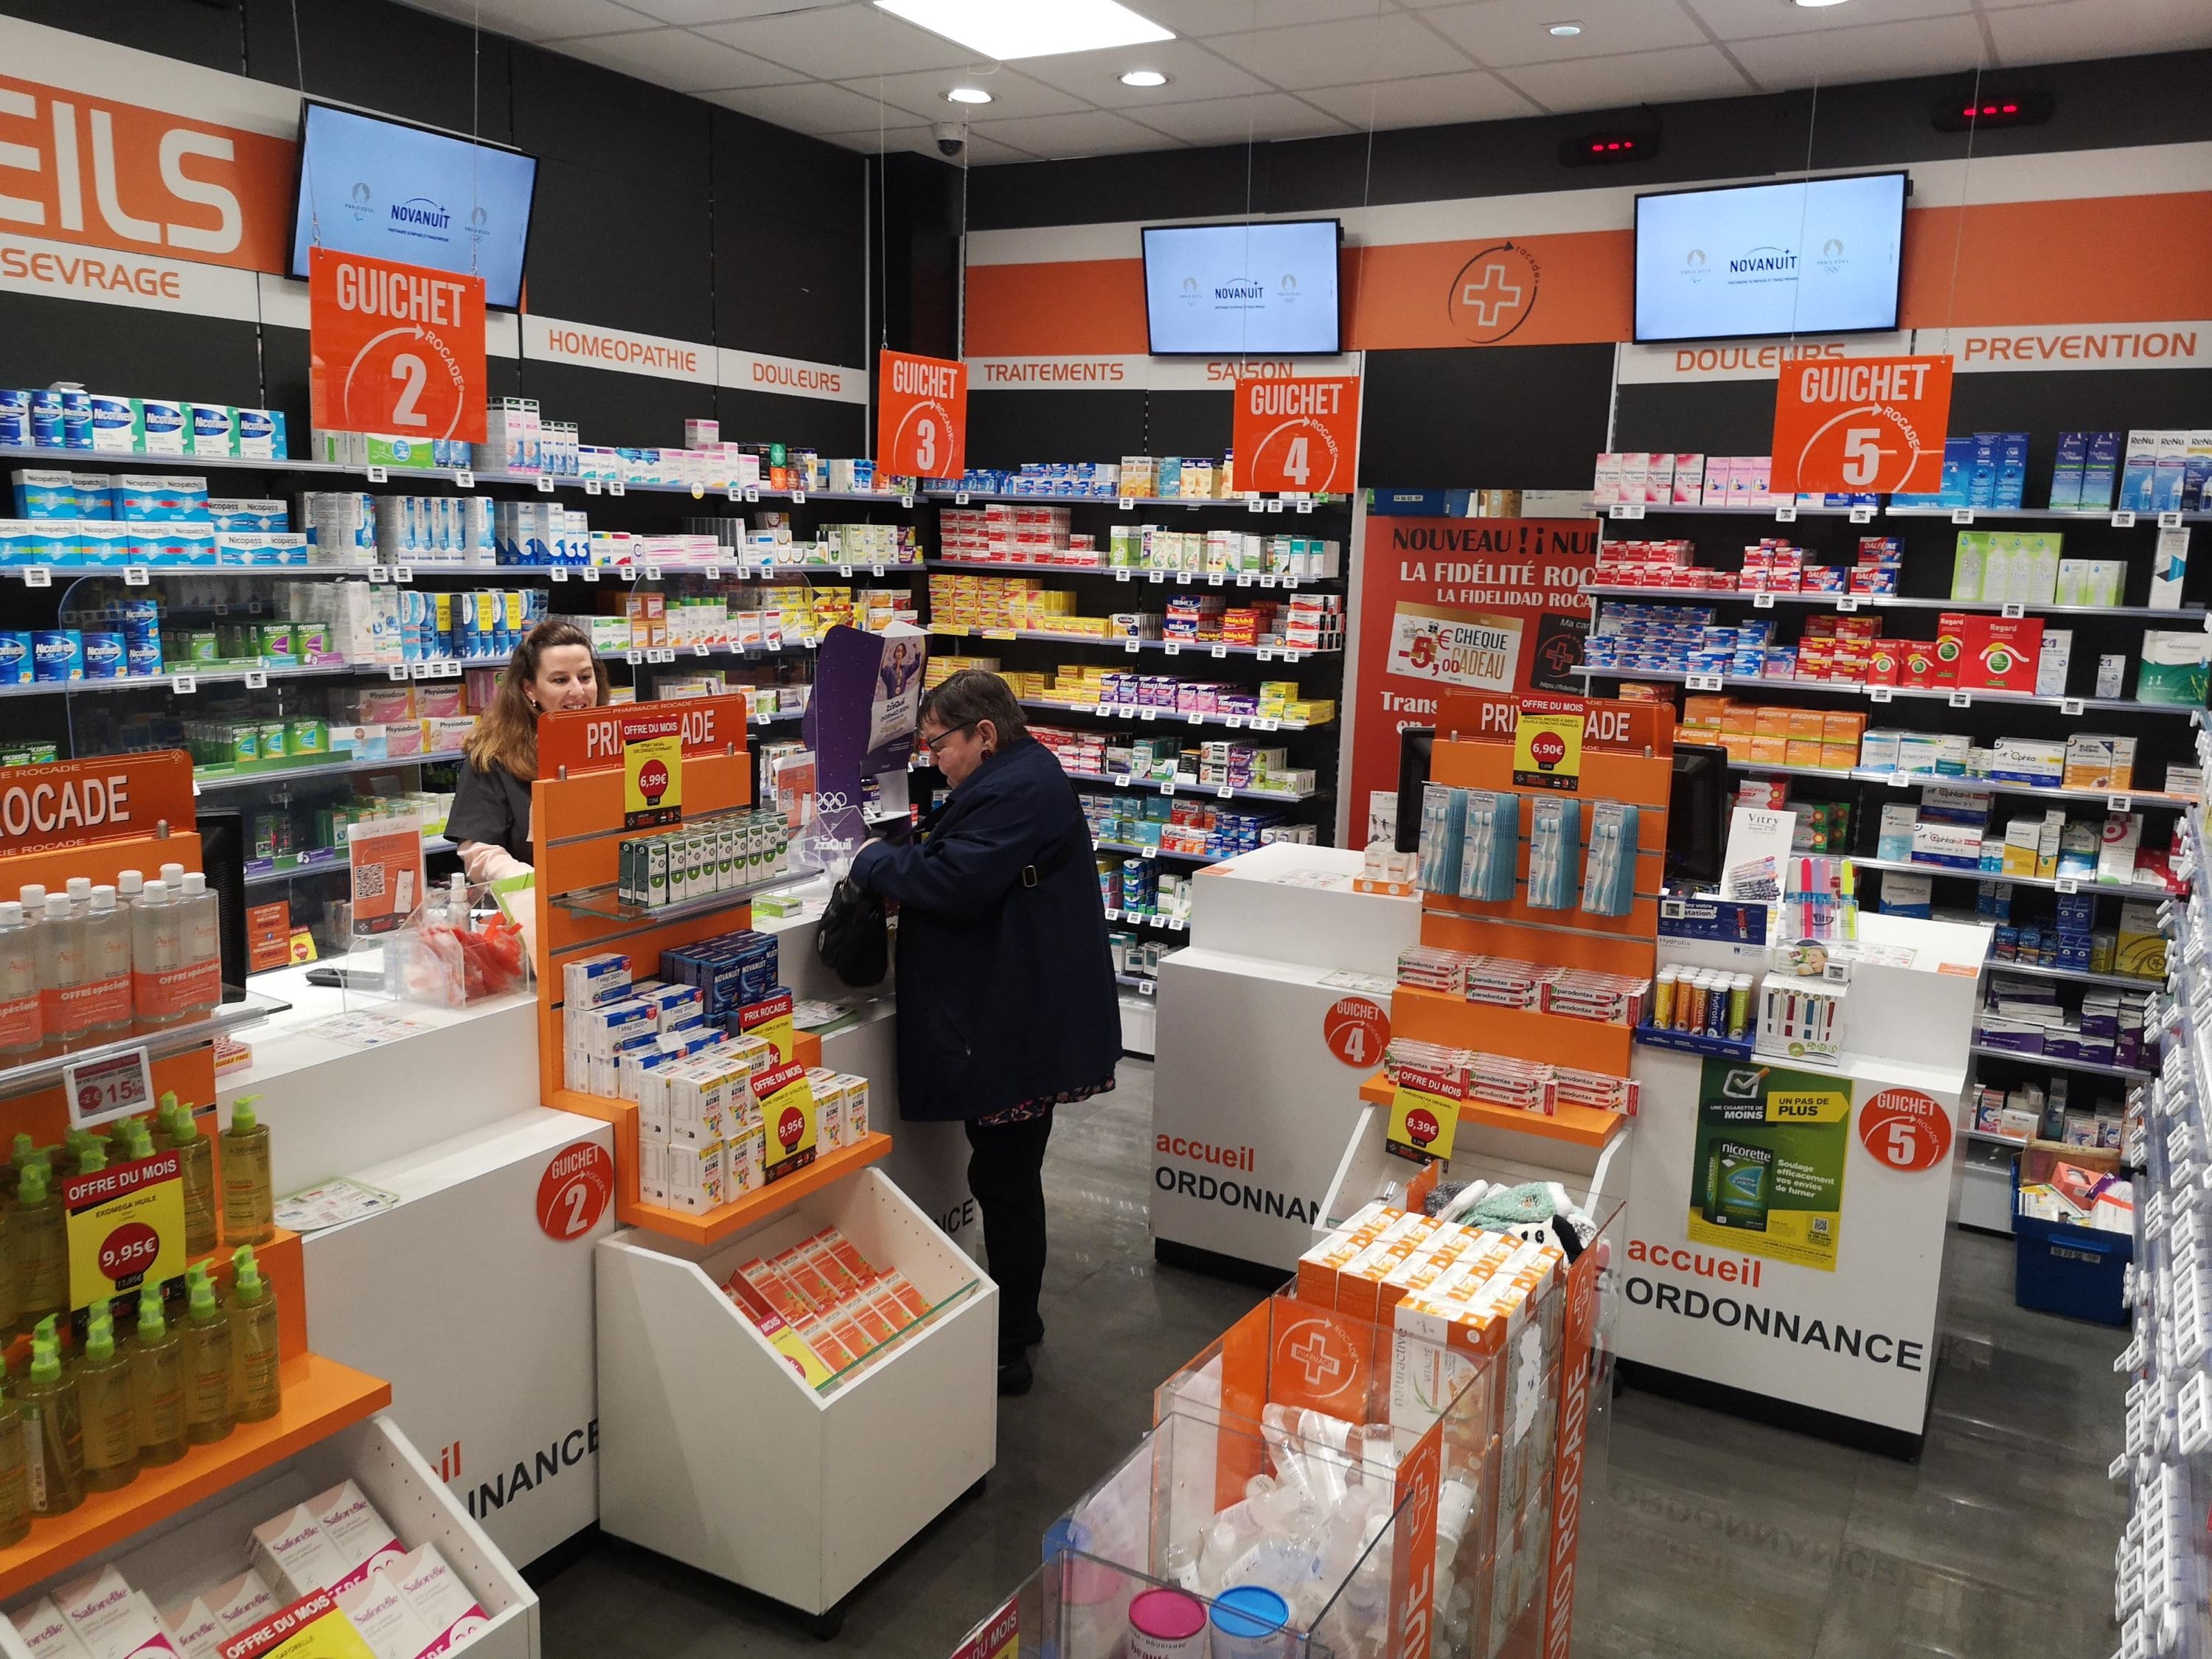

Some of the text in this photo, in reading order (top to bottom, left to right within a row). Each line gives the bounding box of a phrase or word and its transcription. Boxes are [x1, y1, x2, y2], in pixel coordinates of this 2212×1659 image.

[391, 204, 451, 229] NOVANUIT
[1, 247, 181, 299] SEVRAGE
[1730, 254, 1798, 274] NOVANUIT
[336, 262, 466, 327] GUICHET
[1214, 285, 1264, 300] NOVANUIT
[549, 328, 698, 372] HOMEOPATHIE
[1965, 332, 2198, 362] PREVENTION
[425, 330, 464, 386] ROCADE
[753, 361, 841, 392] DOULEURS
[893, 359, 959, 400] GUICHET
[984, 363, 1124, 382] TRAITEMENTS
[1206, 361, 1293, 380] SAISON
[391, 353, 428, 427] 2
[1800, 364, 1931, 404] GUICHET
[1250, 383, 1343, 417] GUICHET
[935, 402, 953, 440] ROCADE
[1882, 406, 1920, 448] ROCADE
[917, 419, 936, 471] 3
[1310, 418, 1336, 454] ROCADE
[2131, 437, 2154, 445] ReNu
[2160, 437, 2184, 446] ReNu
[1281, 437, 1310, 485] 4
[1843, 428, 1879, 487] 5
[247, 503, 279, 512] Nicopass
[229, 536, 262, 546] Nicopass
[1393, 527, 1512, 552] NOUVEAU
[1400, 561, 1427, 582] LA
[1434, 559, 1536, 587] FIDÉLITÉ
[1437, 588, 1455, 603] LA
[1460, 589, 1543, 606] FIDELIDAD
[1560, 619, 1574, 627] Ma
[1941, 617, 1964, 627] Regard
[1990, 624, 2017, 633] Regard
[1455, 627, 1509, 650] CHEQUE
[1875, 641, 1896, 650] Regard
[1912, 643, 1933, 651] Regard
[1451, 647, 1506, 680] CADEAU
[612, 700, 693, 715] PHARMACIE ROCADE
[1522, 699, 1584, 712] OFFRE DU MOIS
[624, 721, 678, 735] OFFRE DU MOIS
[1532, 743, 1563, 755] 6,90€
[15, 764, 81, 778] ROCADE
[640, 773, 667, 788] 6,99€
[0, 775, 131, 838] OCADE
[1748, 813, 1780, 826] Vitry
[1659, 937, 1691, 947] Hydratis
[714, 967, 740, 984] NOVANUIT
[742, 959, 766, 975] NOVANUIT
[1403, 960, 1435, 970] parodontax
[1402, 973, 1434, 984] parodontax
[1472, 976, 1508, 987] parodontax
[1471, 991, 1507, 1001] parodontax
[1557, 988, 1593, 999] parodontax
[744, 1001, 787, 1023] PRIX ROCADE
[1337, 1001, 1380, 1020] GUICHET
[1556, 1004, 1593, 1014] parodontax
[1711, 992, 1721, 1026] Hydratis
[1344, 1026, 1366, 1062] 4
[754, 1064, 803, 1091] OFFRE DU MOIS
[1401, 1070, 1462, 1097] OFFRE DU MOIS
[1778, 1097, 1829, 1105] UN PAS DE
[1778, 1105, 1818, 1116] PLUS
[1877, 1093, 1935, 1116] GUICHET
[1407, 1116, 1438, 1135] 8,39€
[1724, 1110, 1764, 1120] MOINS
[779, 1117, 804, 1138] 9,95€
[1156, 1133, 1255, 1172] accueil
[1722, 1142, 1772, 1163] nicorette
[1887, 1122, 1916, 1166] 5
[551, 1144, 599, 1180] GUICHET
[1777, 1158, 1814, 1172] Soulage
[69, 1158, 178, 1201] OFFRE DU MOIS
[1775, 1177, 1822, 1191] vos envies
[1776, 1168, 1835, 1186] efficacement
[1775, 1183, 1816, 1199] de fumer
[565, 1183, 588, 1237] 2
[102, 1237, 157, 1267] 9,95€
[1627, 1239, 1761, 1289] accueil
[1625, 1276, 1924, 1372] ORDONNANCE
[1394, 1327, 1408, 1408] naturactive
[467, 1417, 600, 1520] NANCE
[1555, 1351, 1588, 1565] ROCADE
[226, 1594, 332, 1659] OFFRE DU MOIS
[990, 1612, 1018, 1649] MOIS
